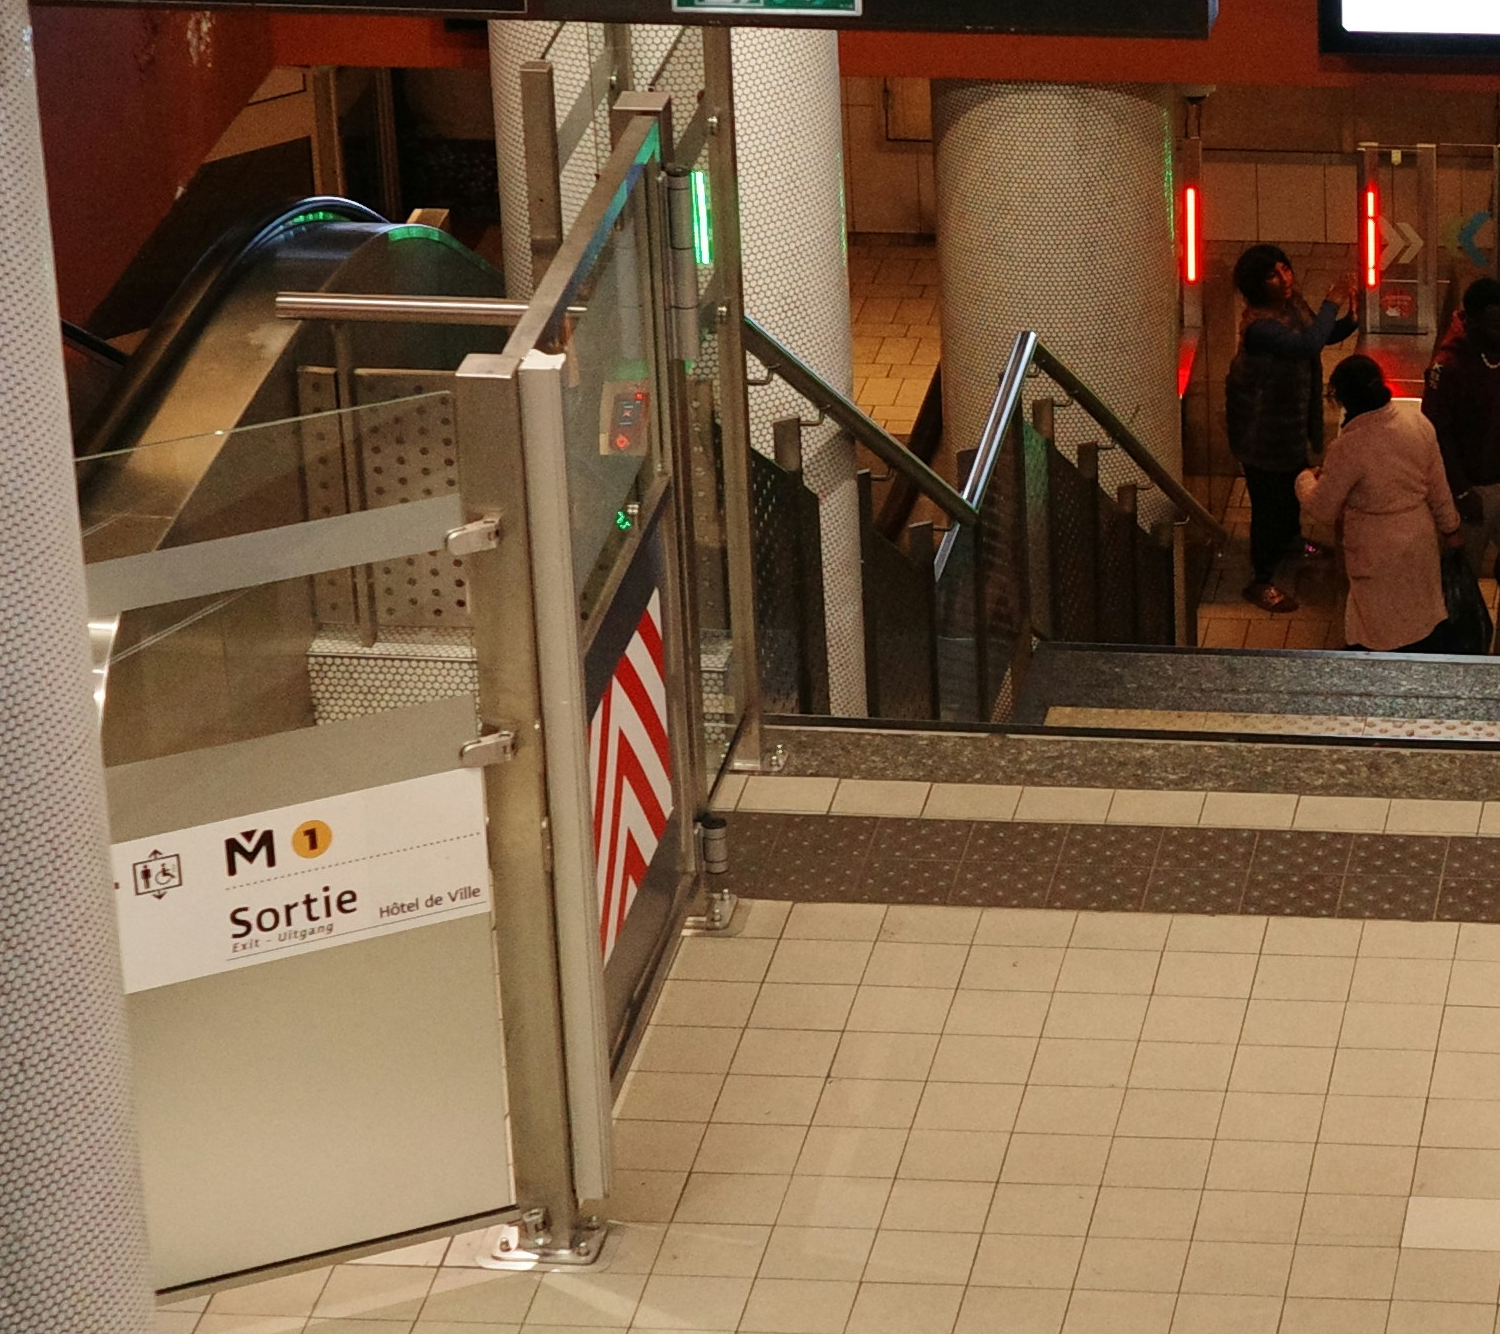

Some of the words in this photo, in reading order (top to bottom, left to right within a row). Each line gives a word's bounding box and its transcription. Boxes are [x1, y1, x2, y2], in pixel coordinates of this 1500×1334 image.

[224, 829, 276, 877] M
[302, 827, 319, 852] 1
[230, 885, 359, 940] Sortie
[379, 897, 420, 919] Hôtel
[424, 893, 444, 909] de
[447, 885, 482, 905] Ville
[231, 936, 261, 953] Exit
[277, 922, 335, 943] Uitgang
